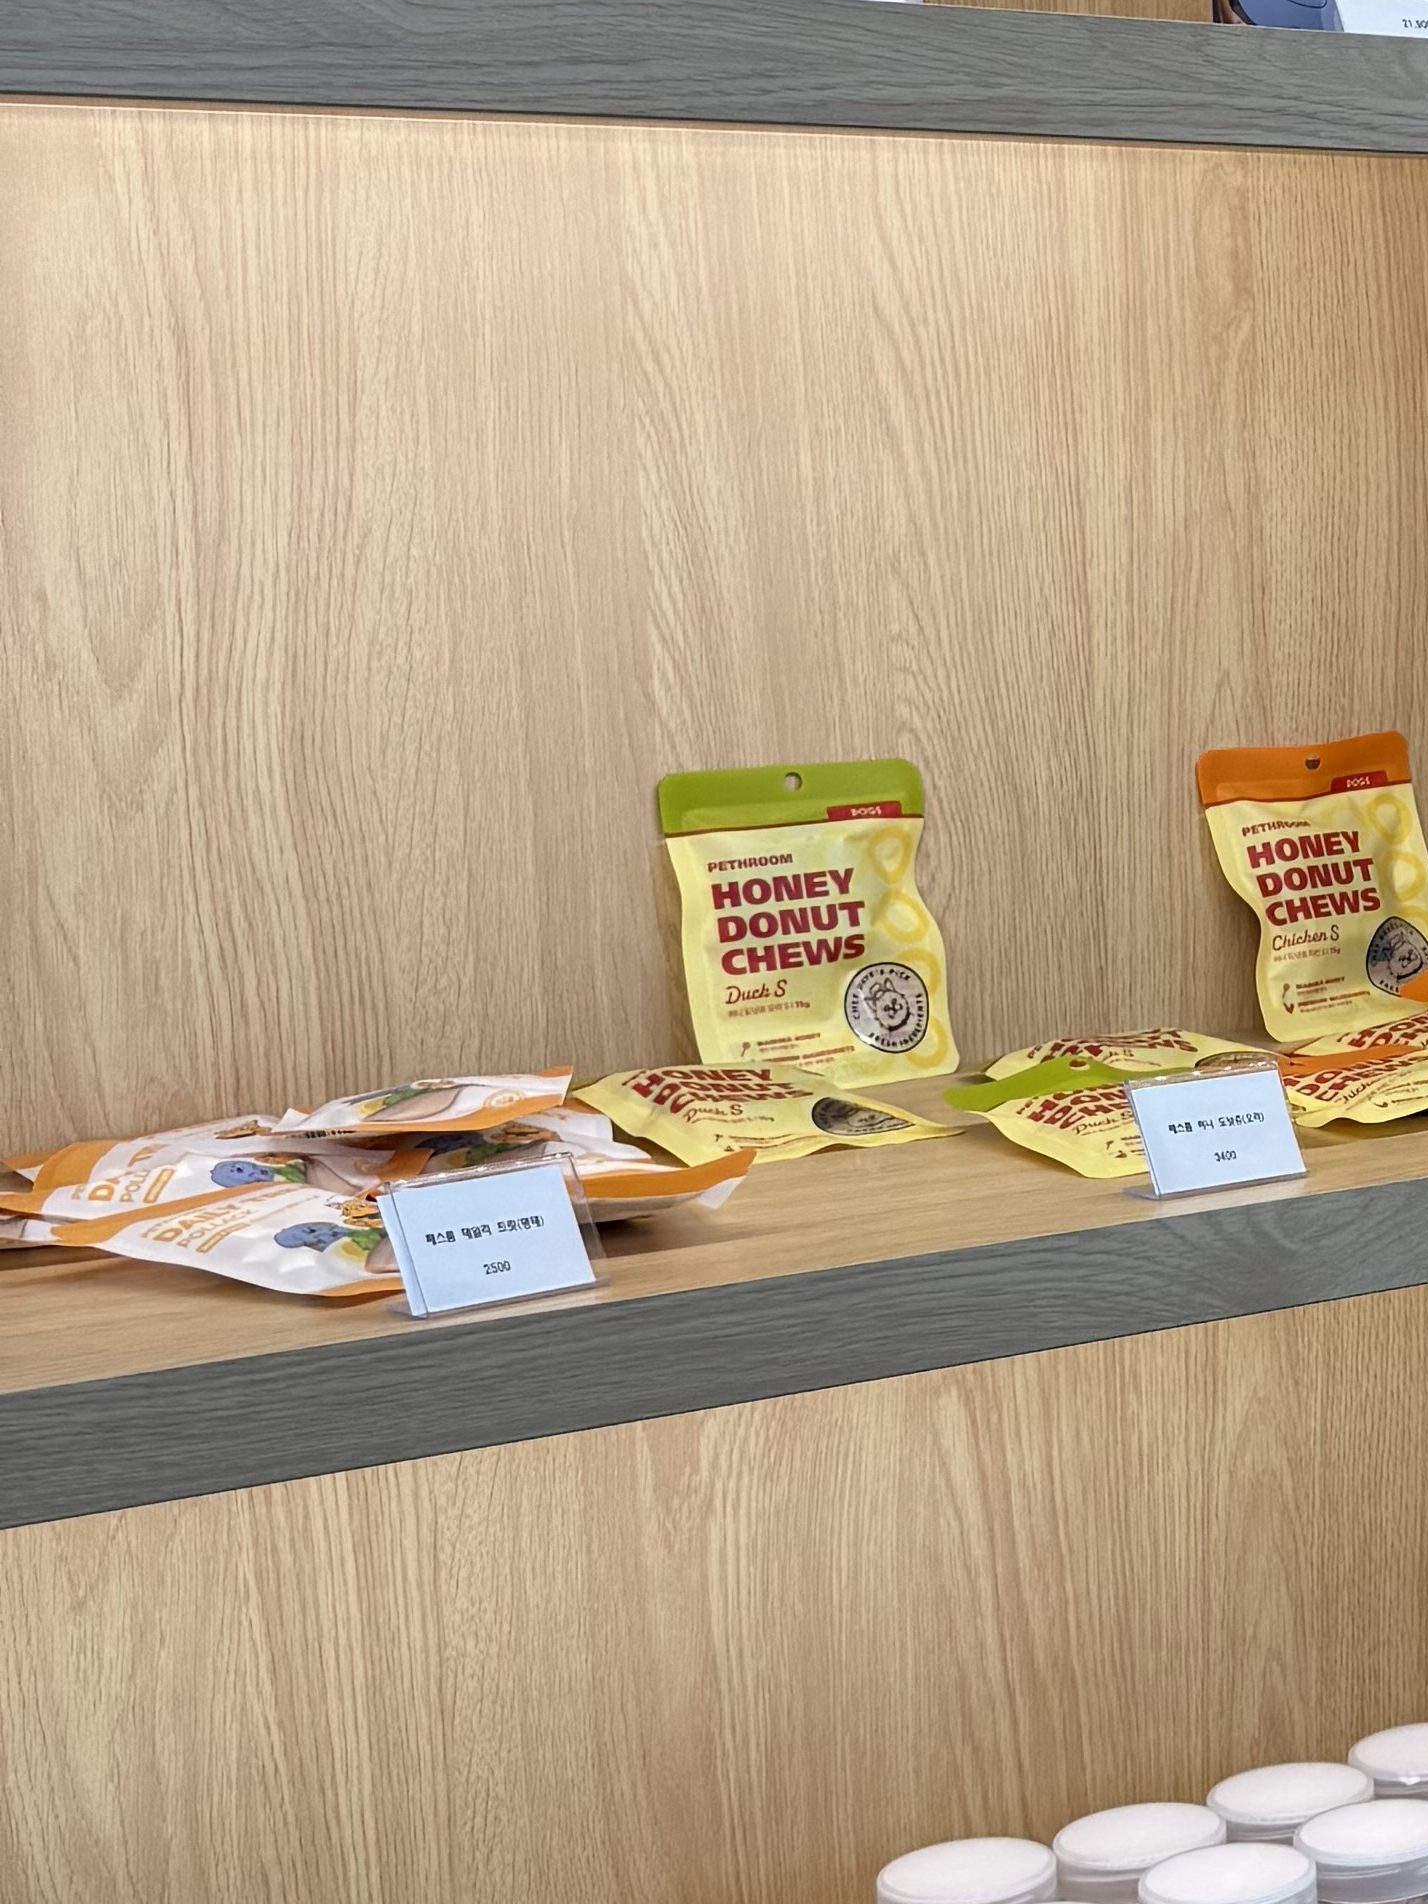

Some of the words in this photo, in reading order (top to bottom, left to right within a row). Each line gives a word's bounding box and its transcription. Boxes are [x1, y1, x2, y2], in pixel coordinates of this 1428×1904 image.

[707, 853, 793, 873] PETHROOM
[1247, 830, 1361, 869] HONEY
[711, 867, 854, 911] HONEY
[1256, 858, 1374, 898] DONUT
[716, 900, 865, 944] DONUT
[1265, 887, 1381, 926] CHEWS
[721, 933, 866, 976] CHEWS
[1272, 929, 1327, 952] Chicken
[1330, 925, 1340, 942] S
[725, 985, 771, 1005] Duck
[774, 979, 788, 998] S
[483, 1260, 511, 1275] 2500
